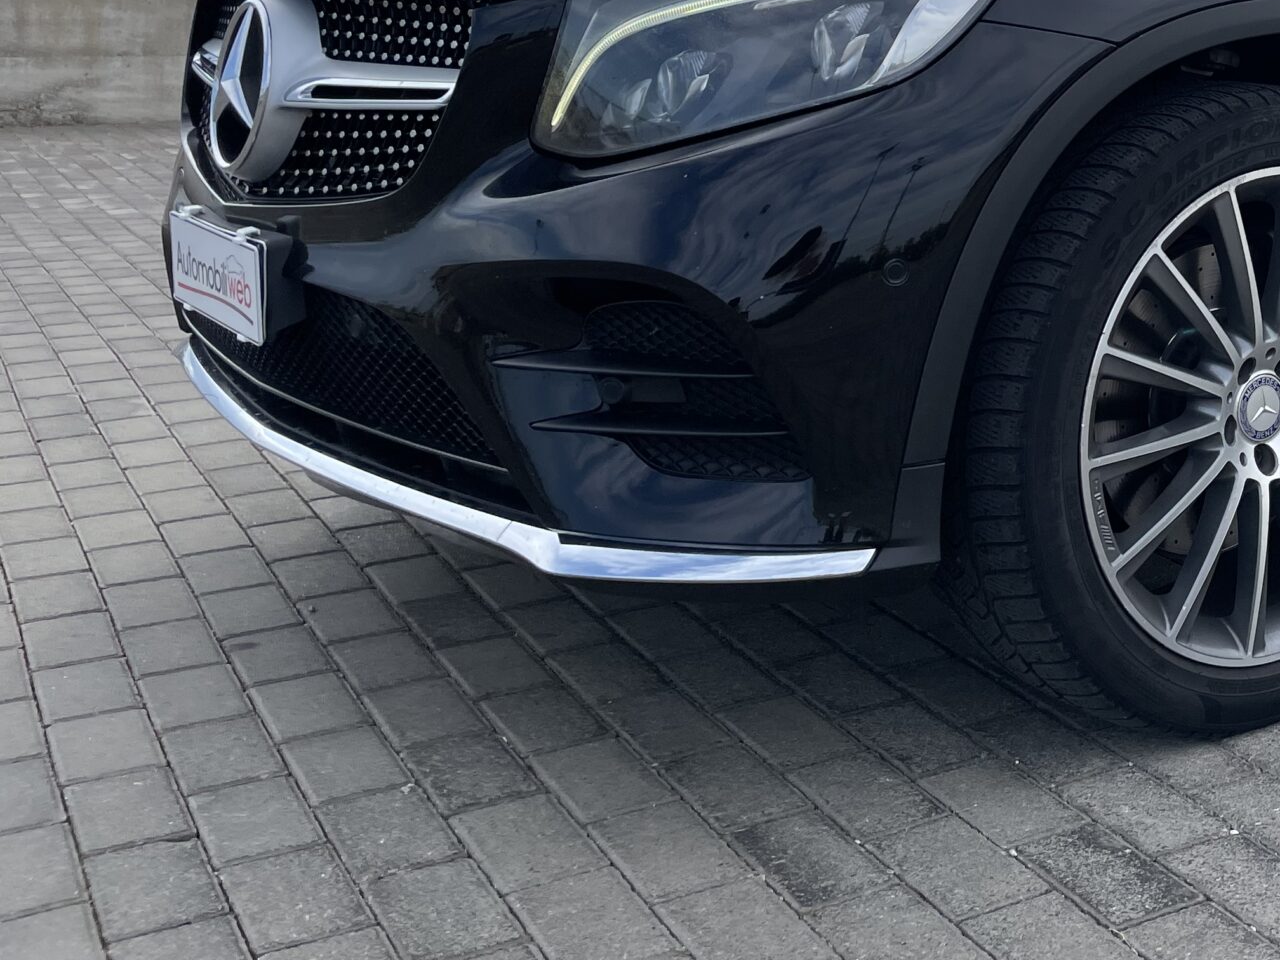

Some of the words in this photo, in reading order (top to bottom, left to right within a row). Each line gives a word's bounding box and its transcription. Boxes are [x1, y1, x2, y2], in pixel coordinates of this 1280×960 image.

[176, 242, 252, 309] Automobiliweb
[1244, 377, 1280, 398] MERCEDES
[1255, 428, 1277, 440] BENZ
